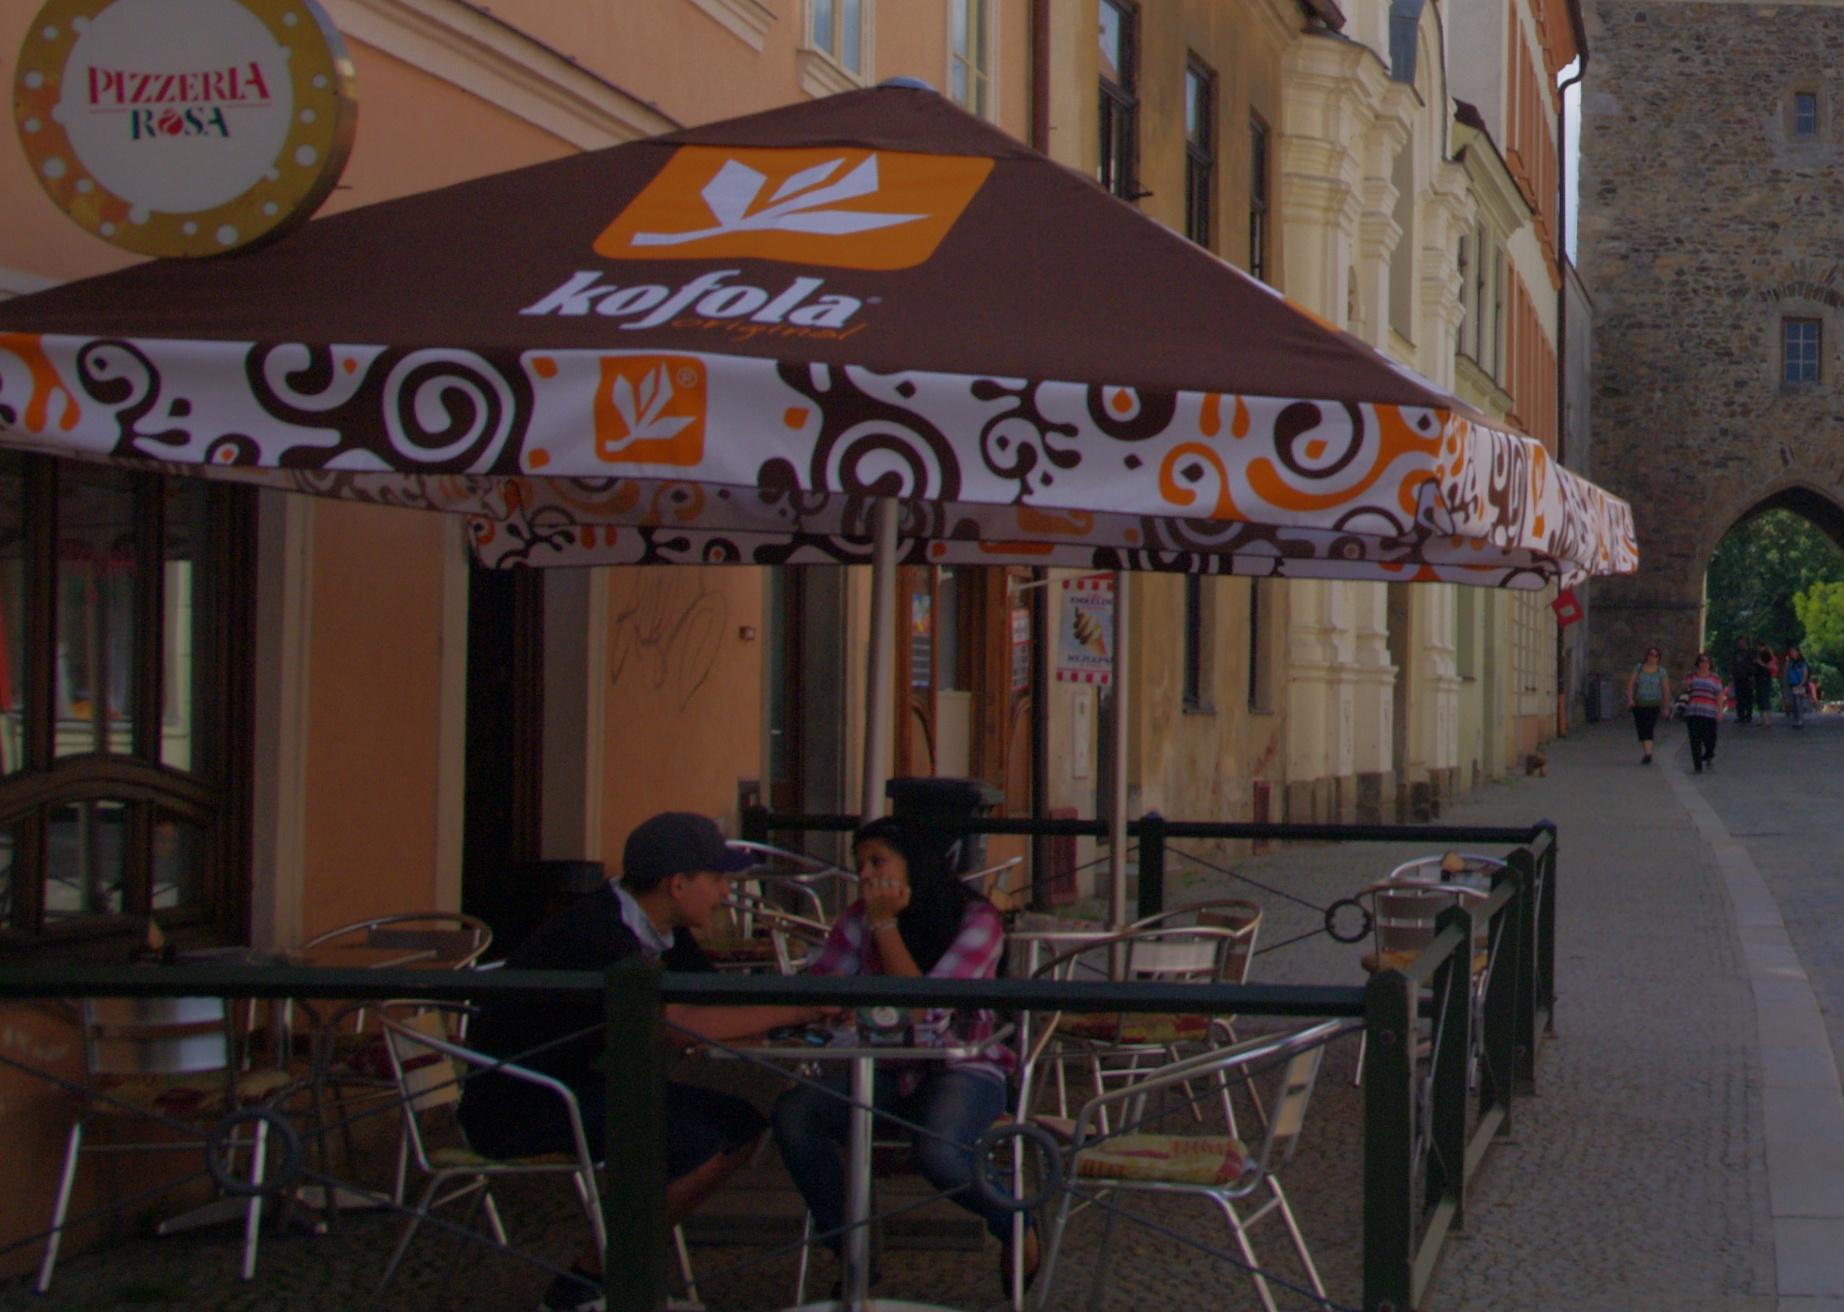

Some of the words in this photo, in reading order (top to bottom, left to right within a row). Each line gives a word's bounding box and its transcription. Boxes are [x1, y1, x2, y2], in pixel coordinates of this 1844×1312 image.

[88, 61, 270, 105] PIZZERIA
[131, 106, 230, 140] ROSA
[519, 269, 862, 329] kofola
